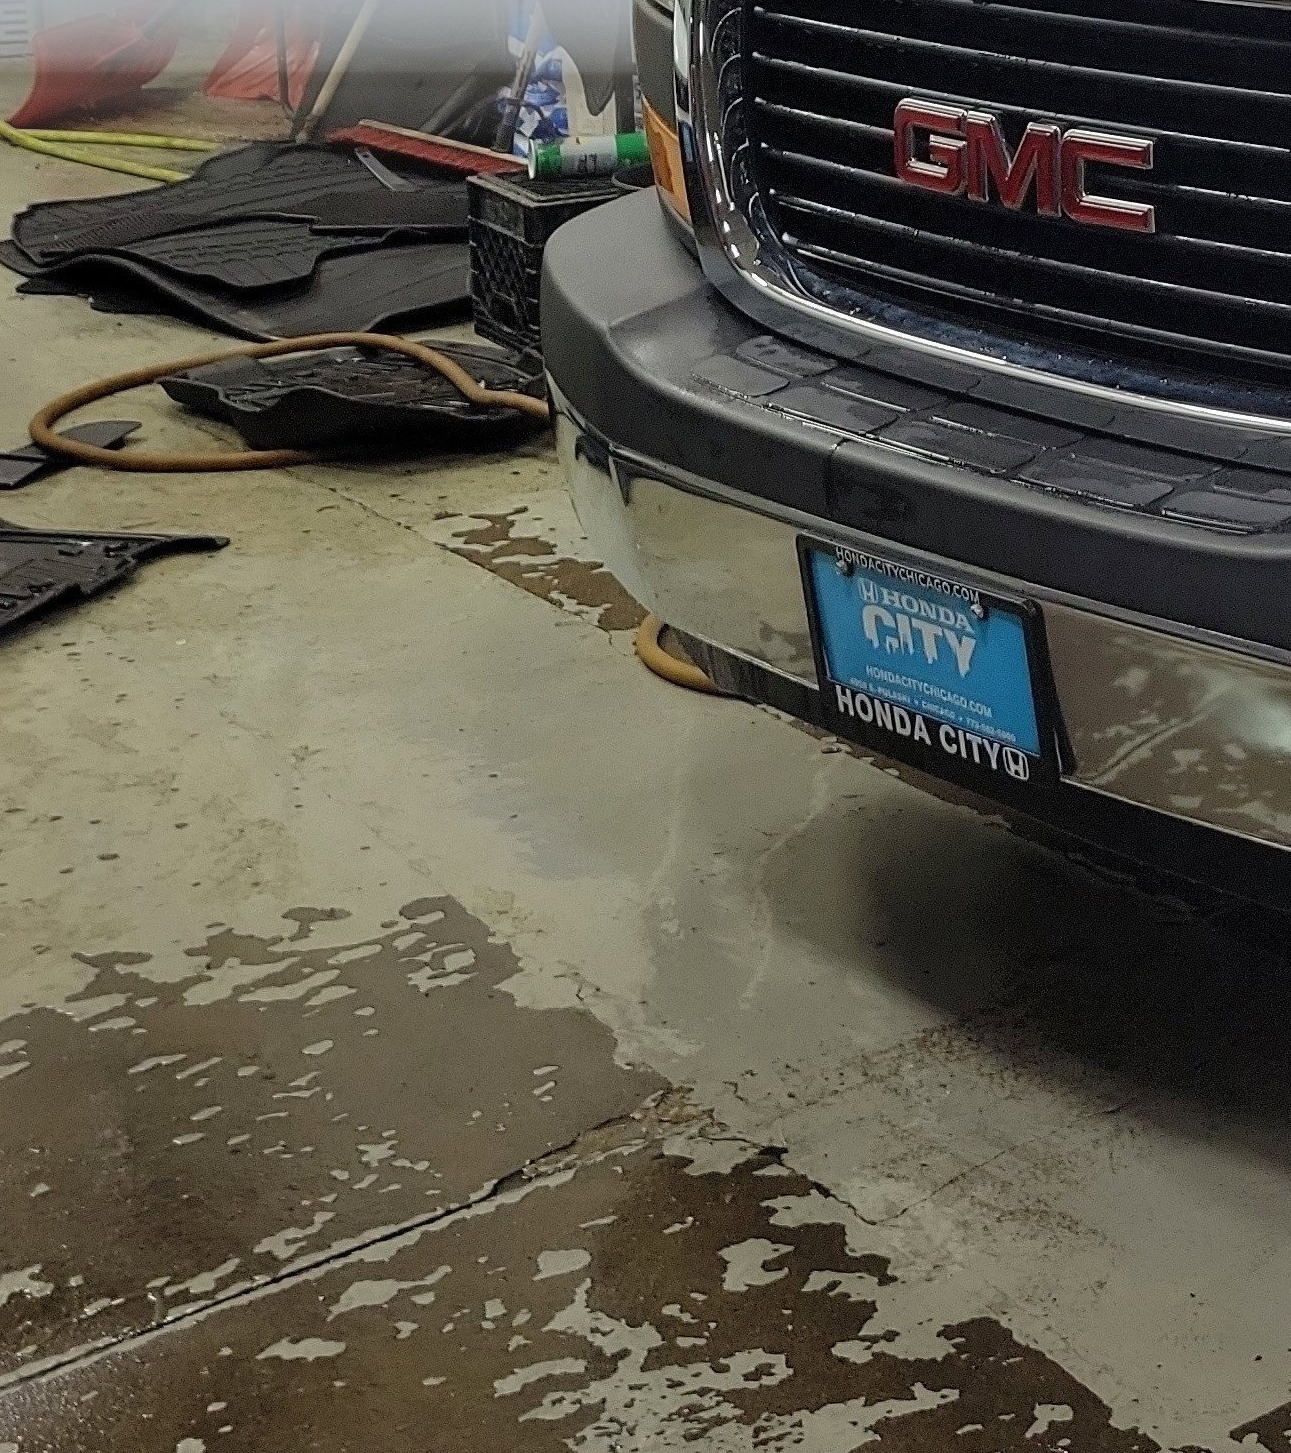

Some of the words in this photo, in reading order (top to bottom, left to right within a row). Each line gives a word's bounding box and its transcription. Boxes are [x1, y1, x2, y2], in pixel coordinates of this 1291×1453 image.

[894, 97, 1156, 234] GMC
[835, 546, 980, 605] HONDACITYCHICAGO.COM
[861, 604, 976, 679] CITY
[879, 585, 976, 635] HONDA
[865, 665, 993, 718] HONDACITYCHICAGO.COM
[835, 685, 932, 746] HONDA
[939, 724, 1001, 770] CITY
